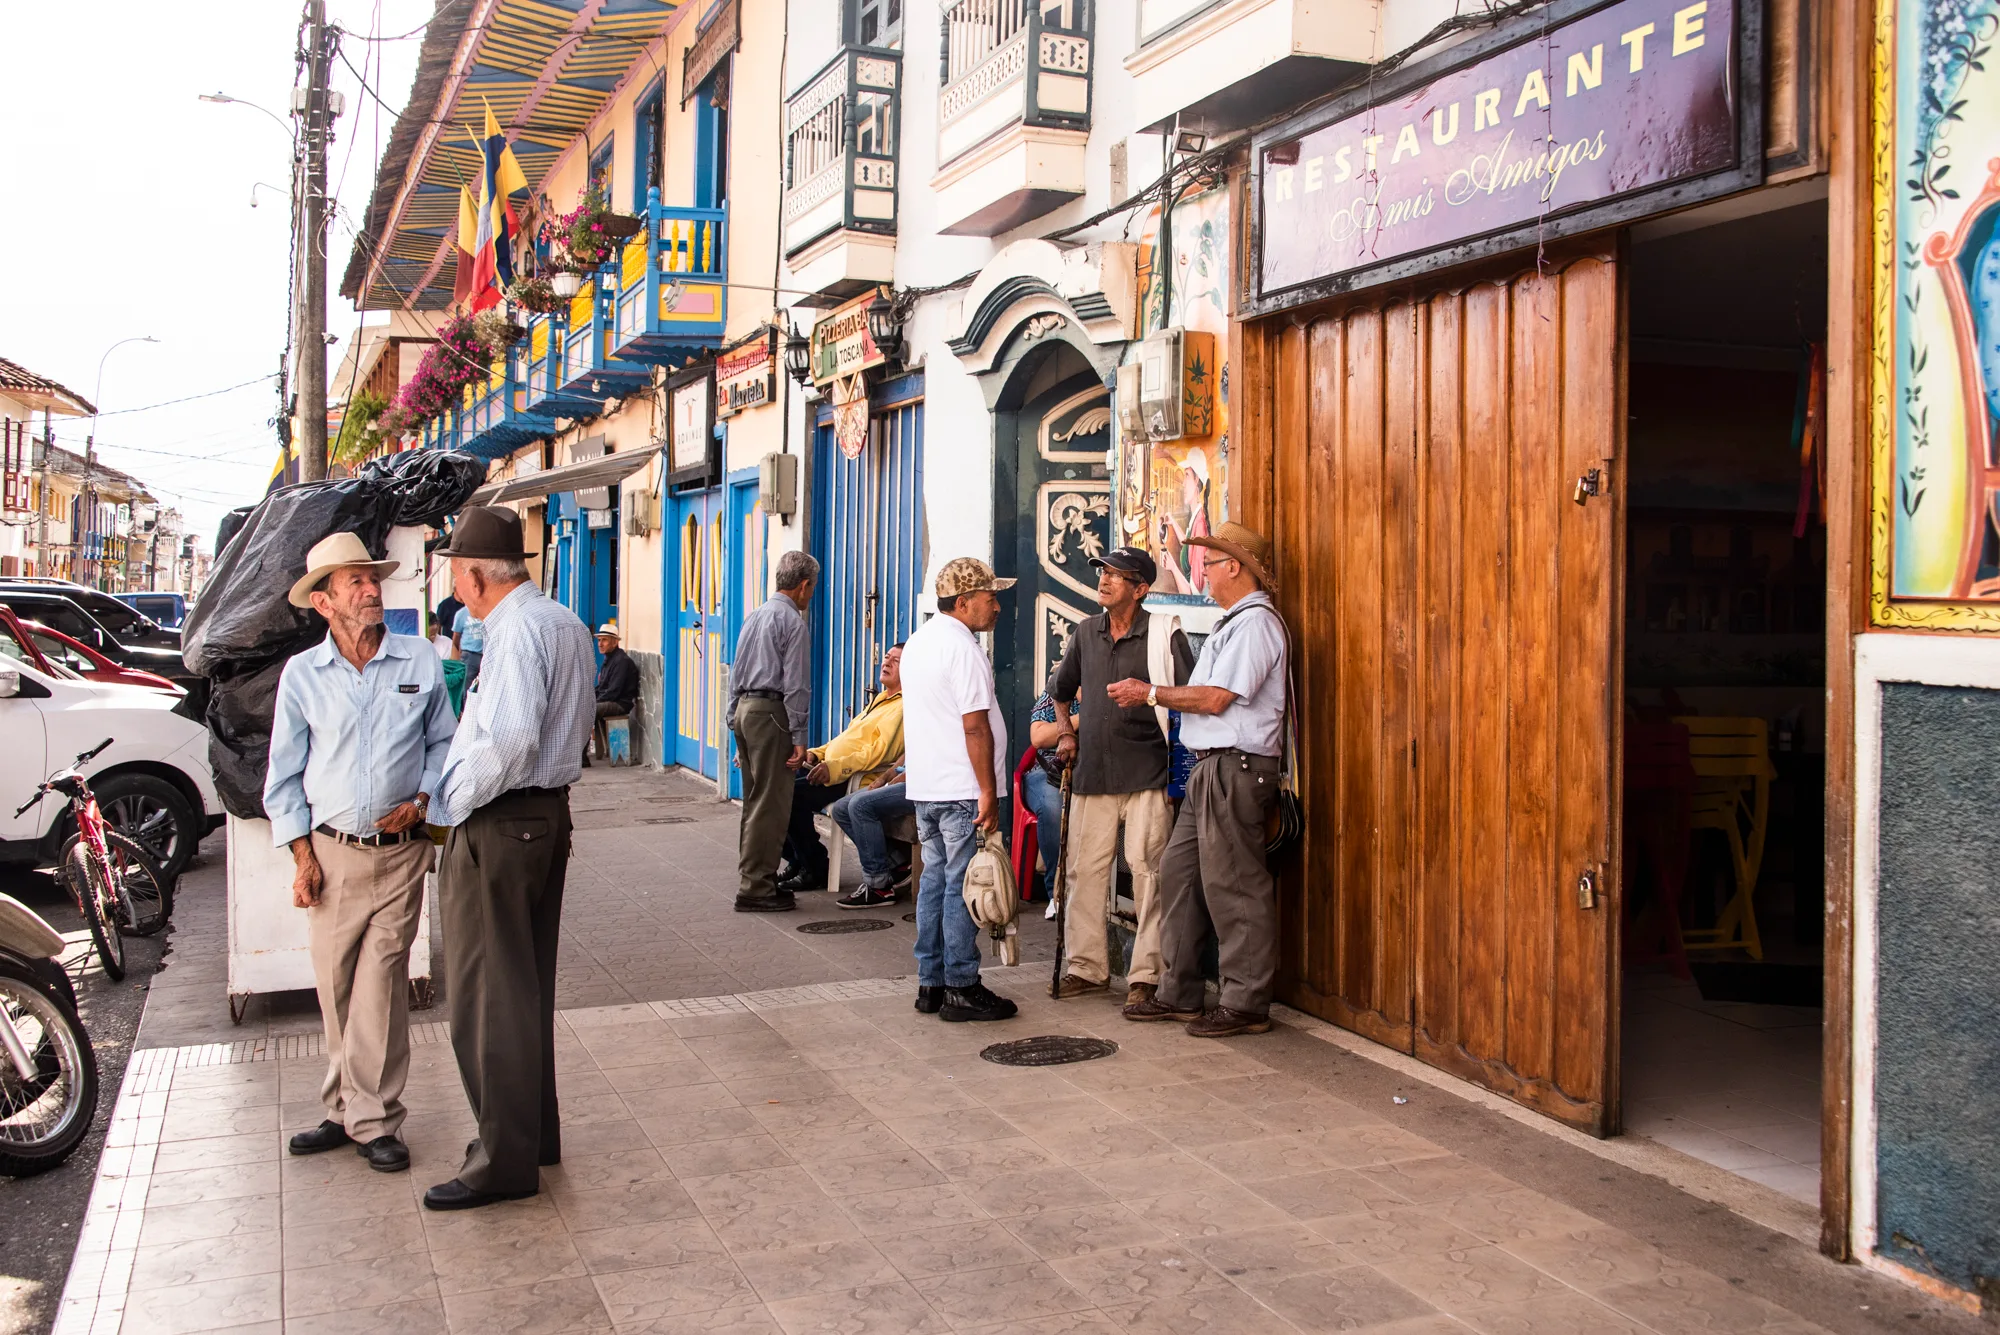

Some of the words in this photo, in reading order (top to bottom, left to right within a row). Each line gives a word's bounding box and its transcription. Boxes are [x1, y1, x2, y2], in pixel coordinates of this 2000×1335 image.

[1275, 1, 1708, 203] RESTAURANTE
[1330, 175, 1435, 242] Amis
[1445, 128, 1607, 206] Amigos
[819, 314, 857, 347] PIZZERIA
[857, 308, 871, 331] BA
[716, 340, 769, 382] Restaurante
[830, 350, 839, 369] LA
[840, 339, 869, 364] TOSCANA
[729, 378, 765, 409] Mariela
